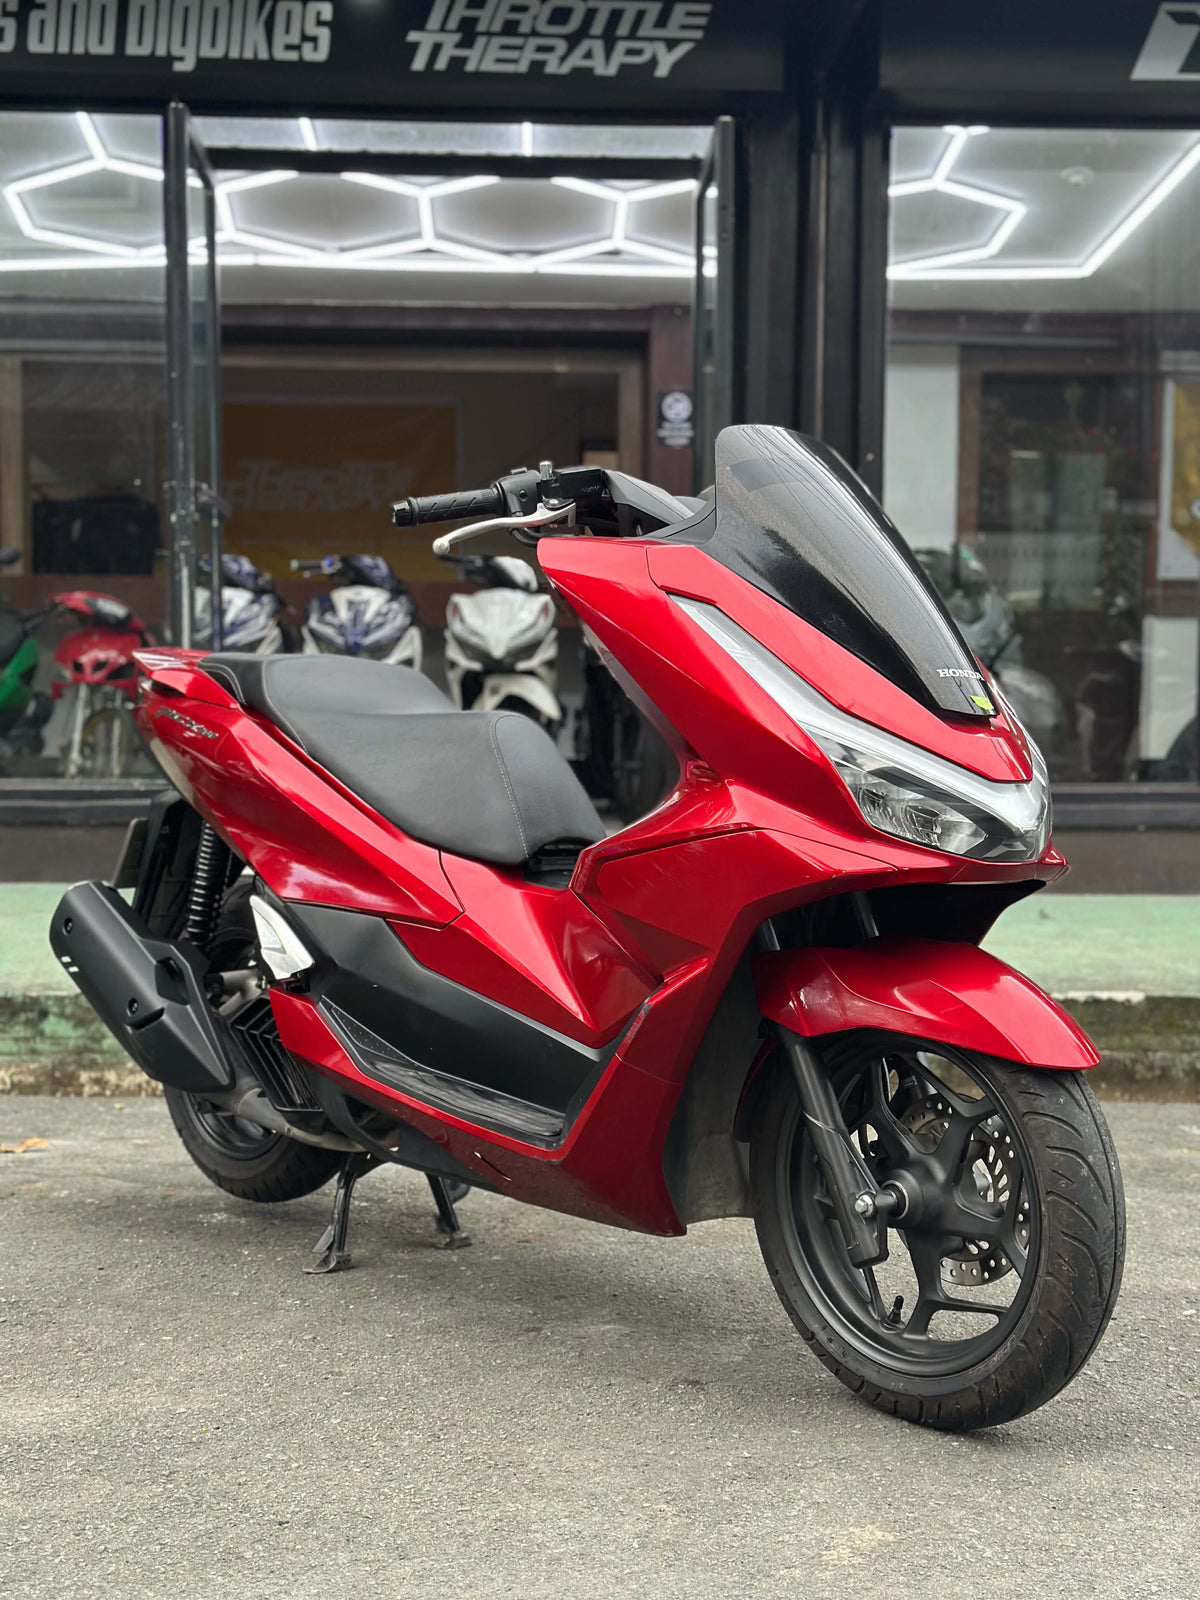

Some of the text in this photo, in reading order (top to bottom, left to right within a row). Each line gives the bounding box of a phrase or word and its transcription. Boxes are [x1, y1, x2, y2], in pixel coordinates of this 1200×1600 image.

[26, 0, 118, 55] and
[124, 0, 333, 72] bigbikes
[424, 0, 713, 39] THROTTLE
[405, 30, 697, 78] THERAPY
[936, 668, 985, 682] HONDA
